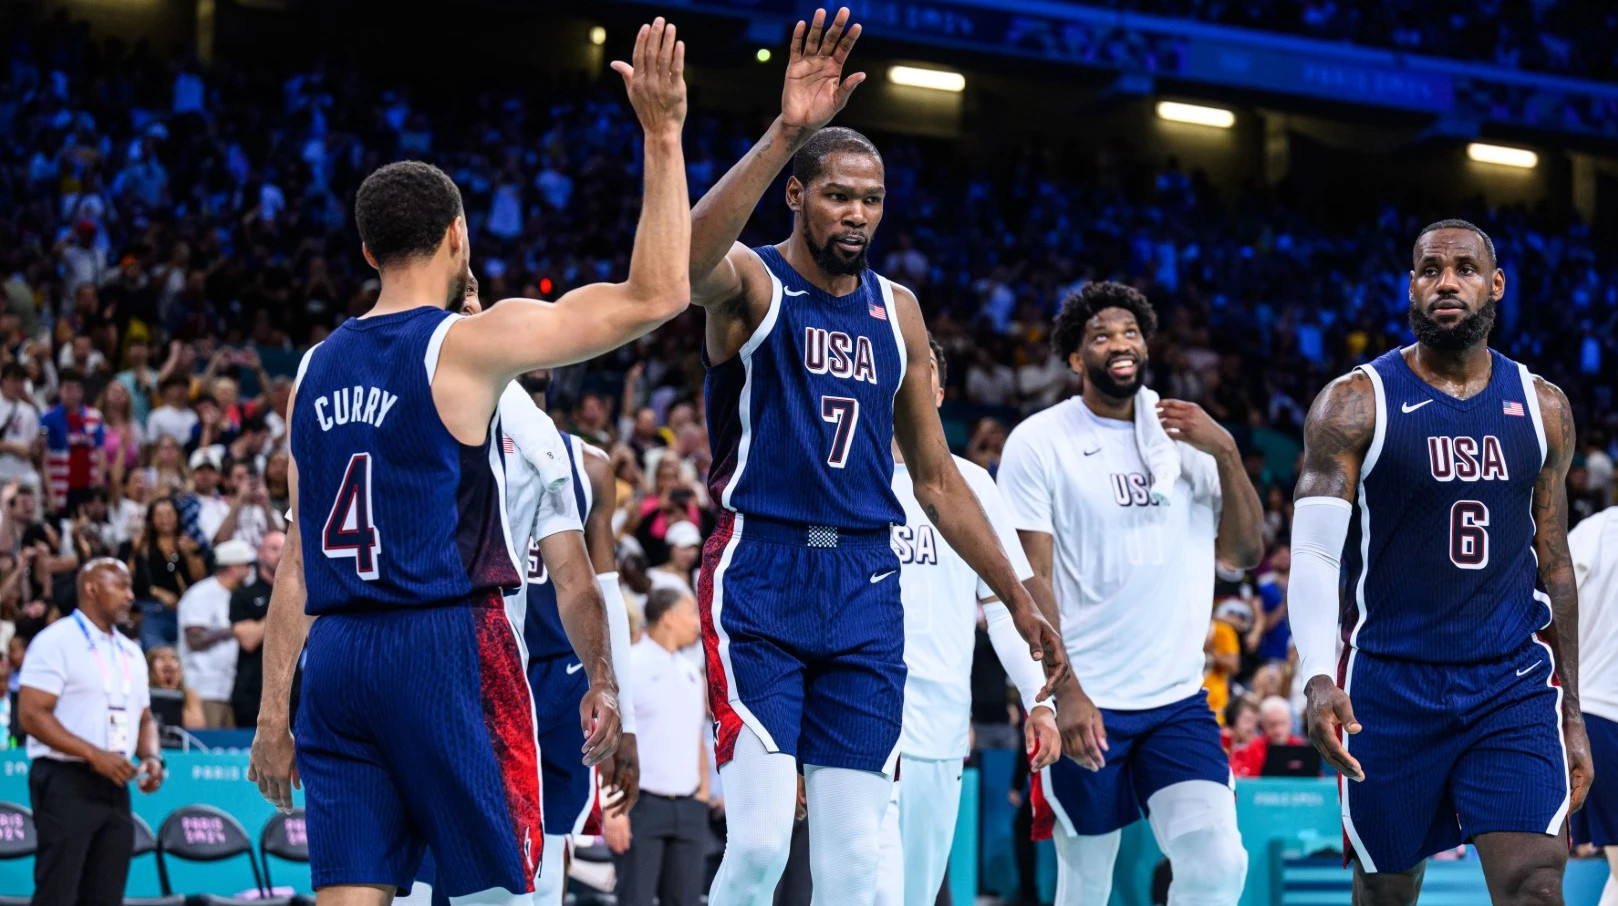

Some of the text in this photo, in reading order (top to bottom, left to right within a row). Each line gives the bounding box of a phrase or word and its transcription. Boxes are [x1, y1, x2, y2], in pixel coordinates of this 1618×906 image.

[804, 326, 877, 385] USA
[314, 385, 398, 432] CURRY
[820, 396, 860, 469] 7
[1427, 434, 1510, 483] USA
[322, 452, 381, 581] 4
[1110, 472, 1160, 507] US
[891, 524, 938, 565] SA
[1449, 499, 1490, 570] 6
